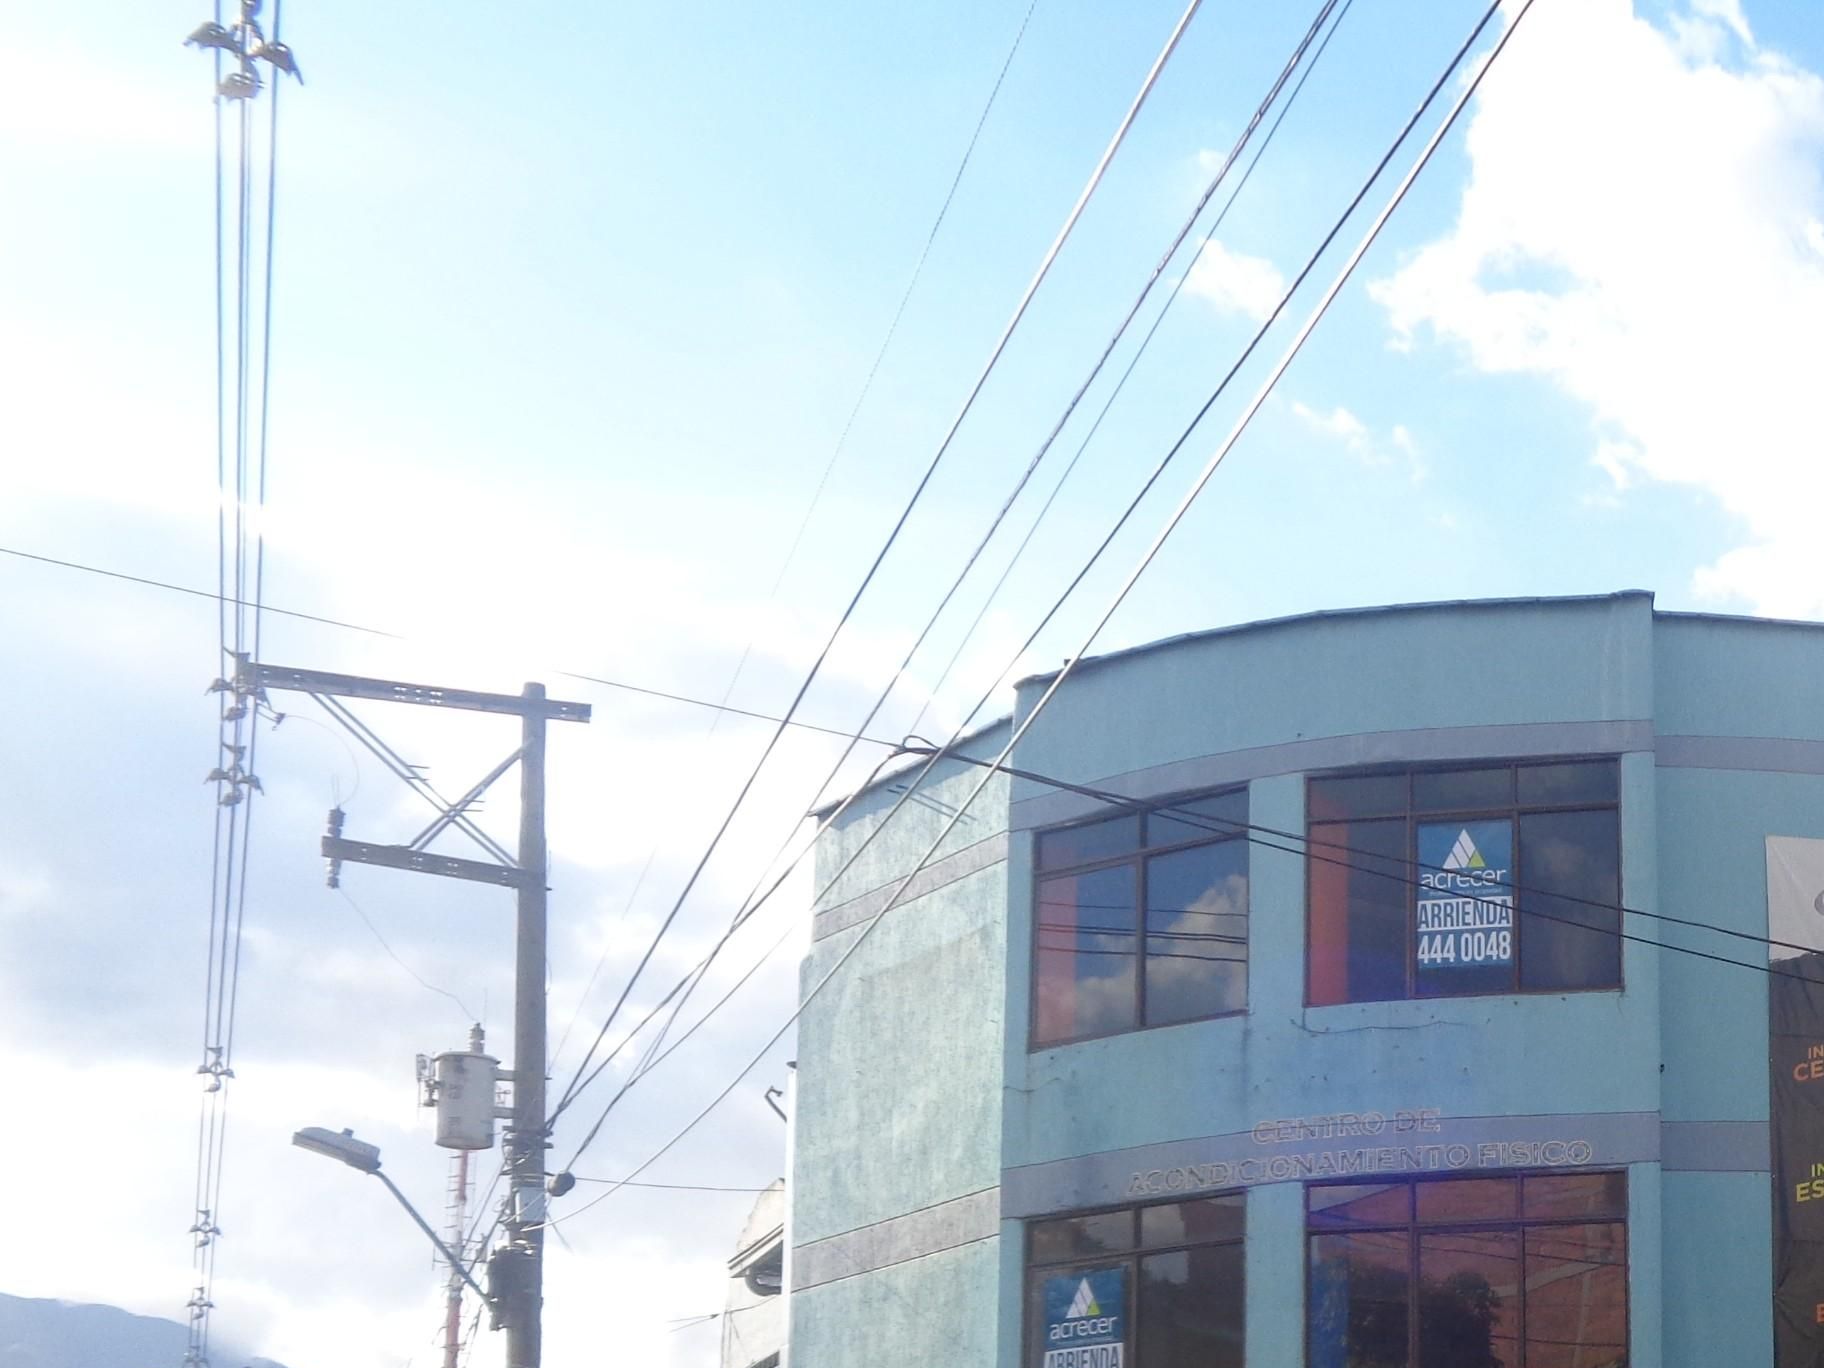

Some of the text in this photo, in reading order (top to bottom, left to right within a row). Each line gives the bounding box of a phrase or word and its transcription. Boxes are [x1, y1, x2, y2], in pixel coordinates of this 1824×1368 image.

[1419, 869, 1506, 890] acrecer
[1419, 898, 1511, 928] ARRIENDA
[1417, 931, 1512, 964] 444 0048
[1252, 1112, 1386, 1144] CENTRO
[1126, 1140, 1593, 1196] ACONDICIONAMIENTO FISICO
[1050, 1316, 1119, 1340] acrecer
